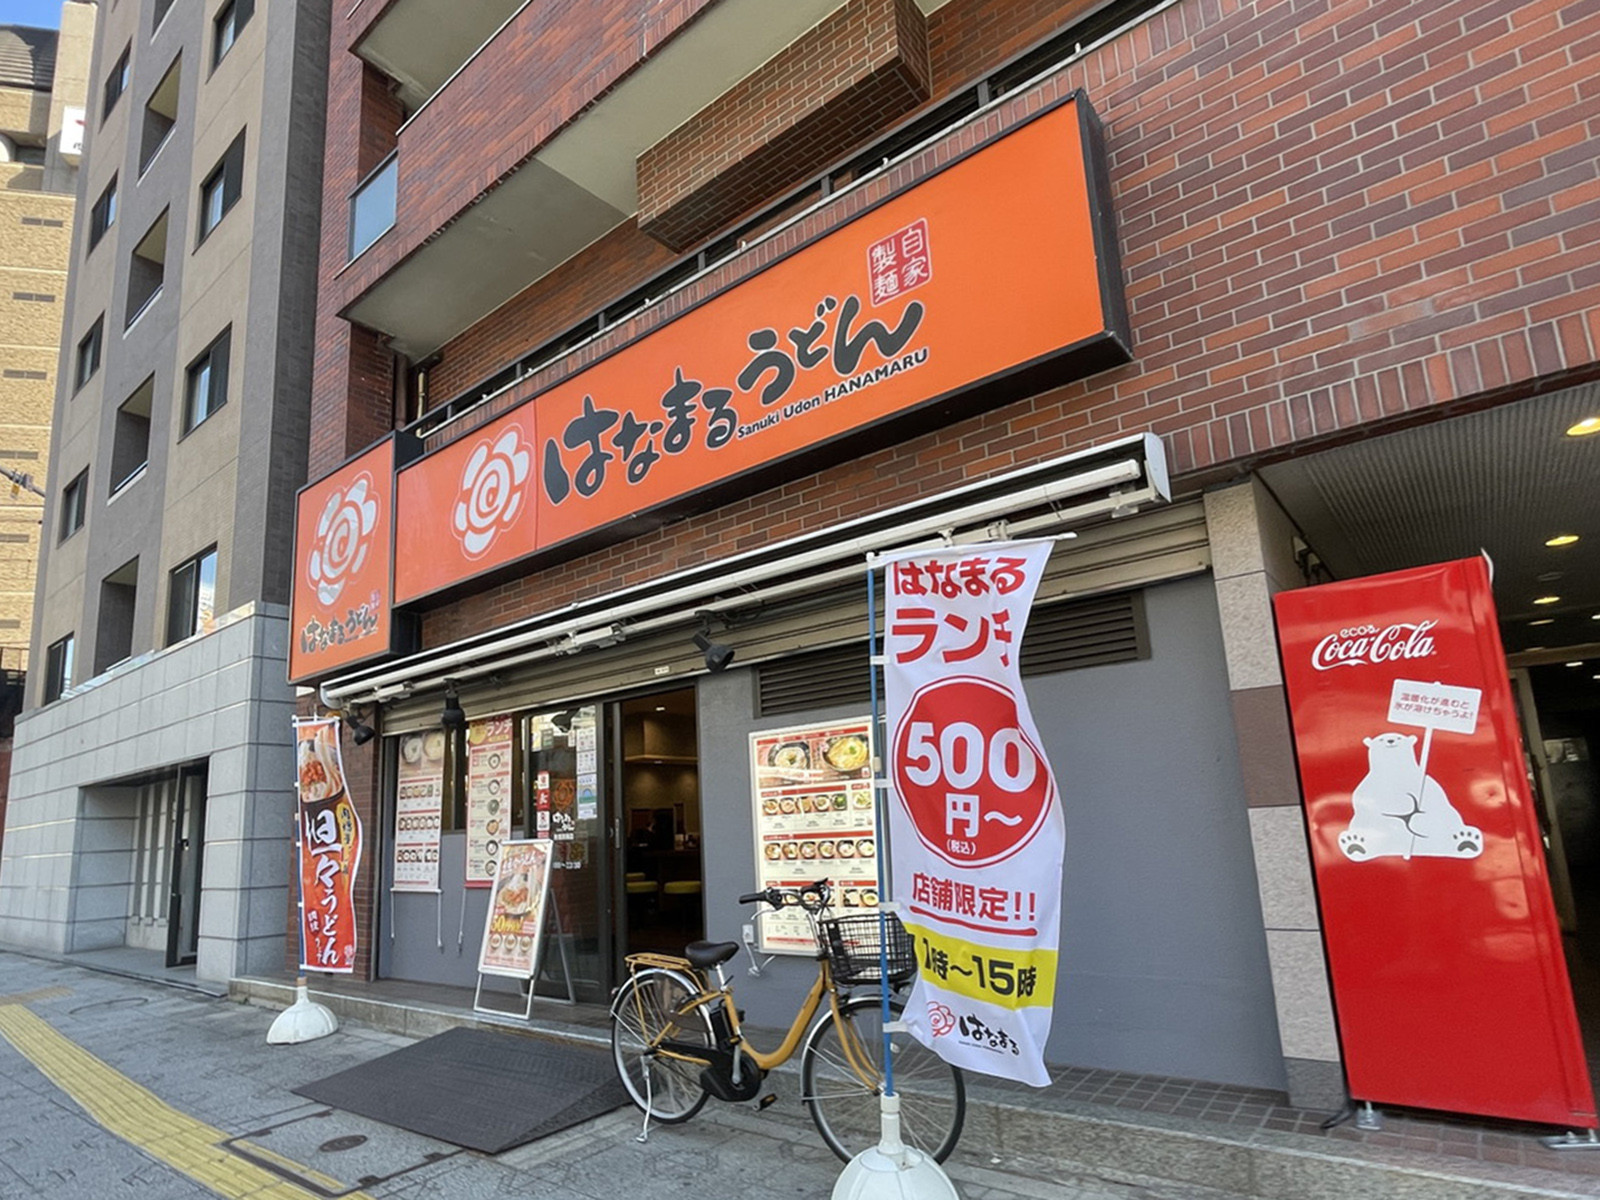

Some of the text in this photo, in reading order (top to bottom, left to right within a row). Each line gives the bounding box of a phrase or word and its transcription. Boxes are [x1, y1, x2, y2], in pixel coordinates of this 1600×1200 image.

[871, 237, 901, 304] 製麺
[901, 227, 929, 288] 自家
[542, 295, 924, 505] はなまるうどん
[737, 348, 928, 438] Sanuki Udon HANAMARU
[892, 556, 1027, 599] はなまる
[300, 603, 378, 654] はなまるうどん
[1311, 619, 1439, 671] Coca-Cola
[904, 721, 1038, 793] 500
[912, 872, 1036, 922] 店舗限定!!
[959, 1013, 1020, 1056] はなまる
